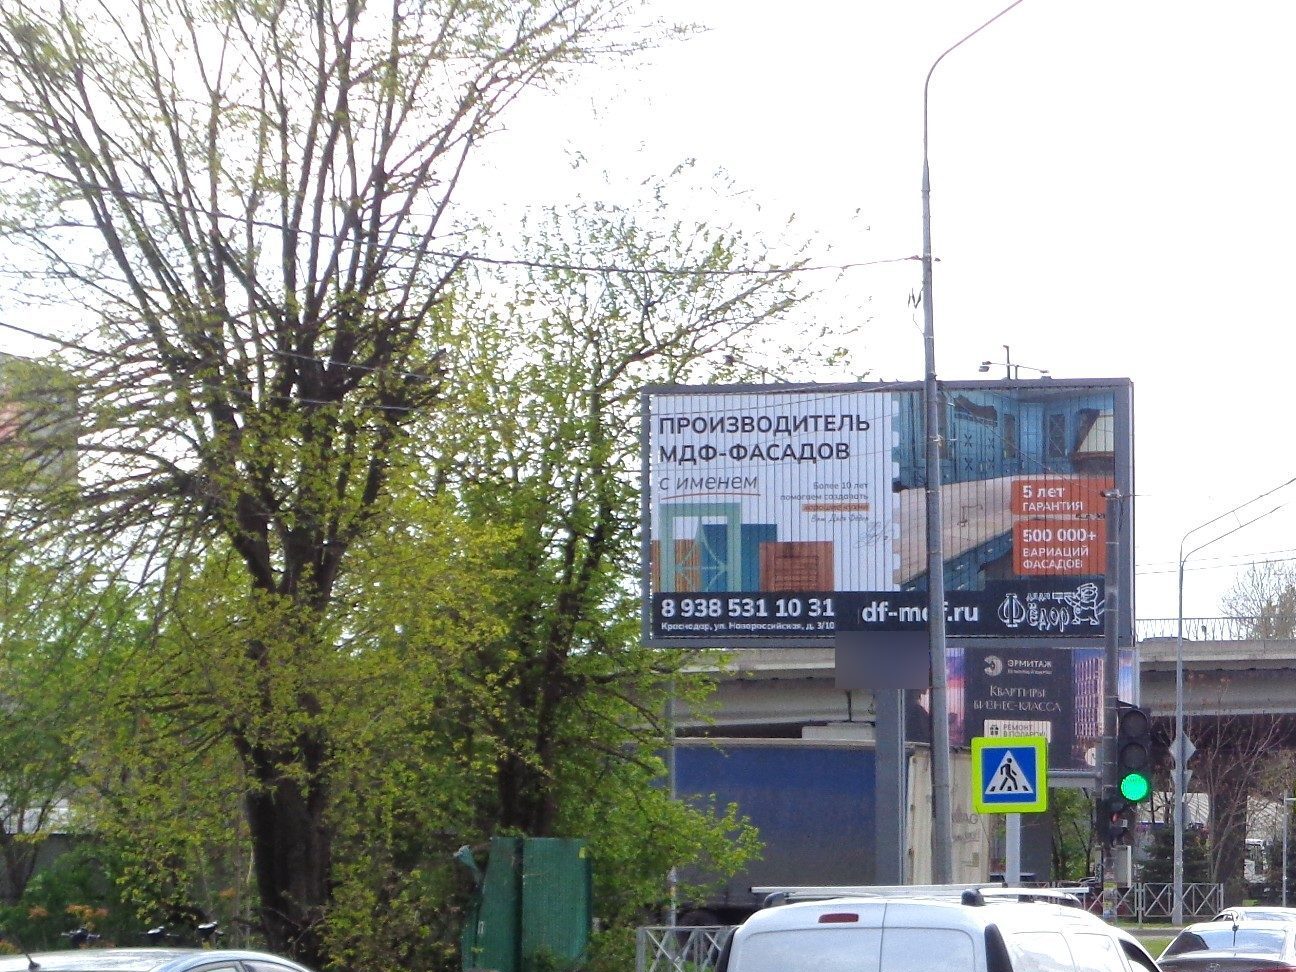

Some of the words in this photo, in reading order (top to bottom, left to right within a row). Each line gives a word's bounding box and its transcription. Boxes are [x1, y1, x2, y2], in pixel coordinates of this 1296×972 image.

[658, 414, 871, 437] ПРОИЗВОДИТЕЛЬ
[658, 442, 851, 466] МДФ-ФАСАДОВ
[675, 475, 759, 491] именем
[1022, 485, 1033, 499] 5
[1036, 487, 1066, 498] лет
[1022, 502, 1083, 512] ГАРАНТИЯ
[1022, 529, 1052, 543] 500
[1057, 528, 1097, 542] 000+
[1022, 545, 1089, 558] ВАРИАЦИЙ
[1022, 559, 1084, 571] ФАСАДОВ
[661, 599, 675, 618] 8
[680, 598, 722, 618] 938
[728, 598, 769, 618] 531
[775, 598, 802, 617] 10
[808, 598, 836, 617] 31
[660, 622, 713, 632] Краснодар,
[817, 621, 836, 631] 3/10
[1007, 659, 1052, 668] ЭРМИТАЖ
[1003, 723, 1033, 731] РЕМОНТ
